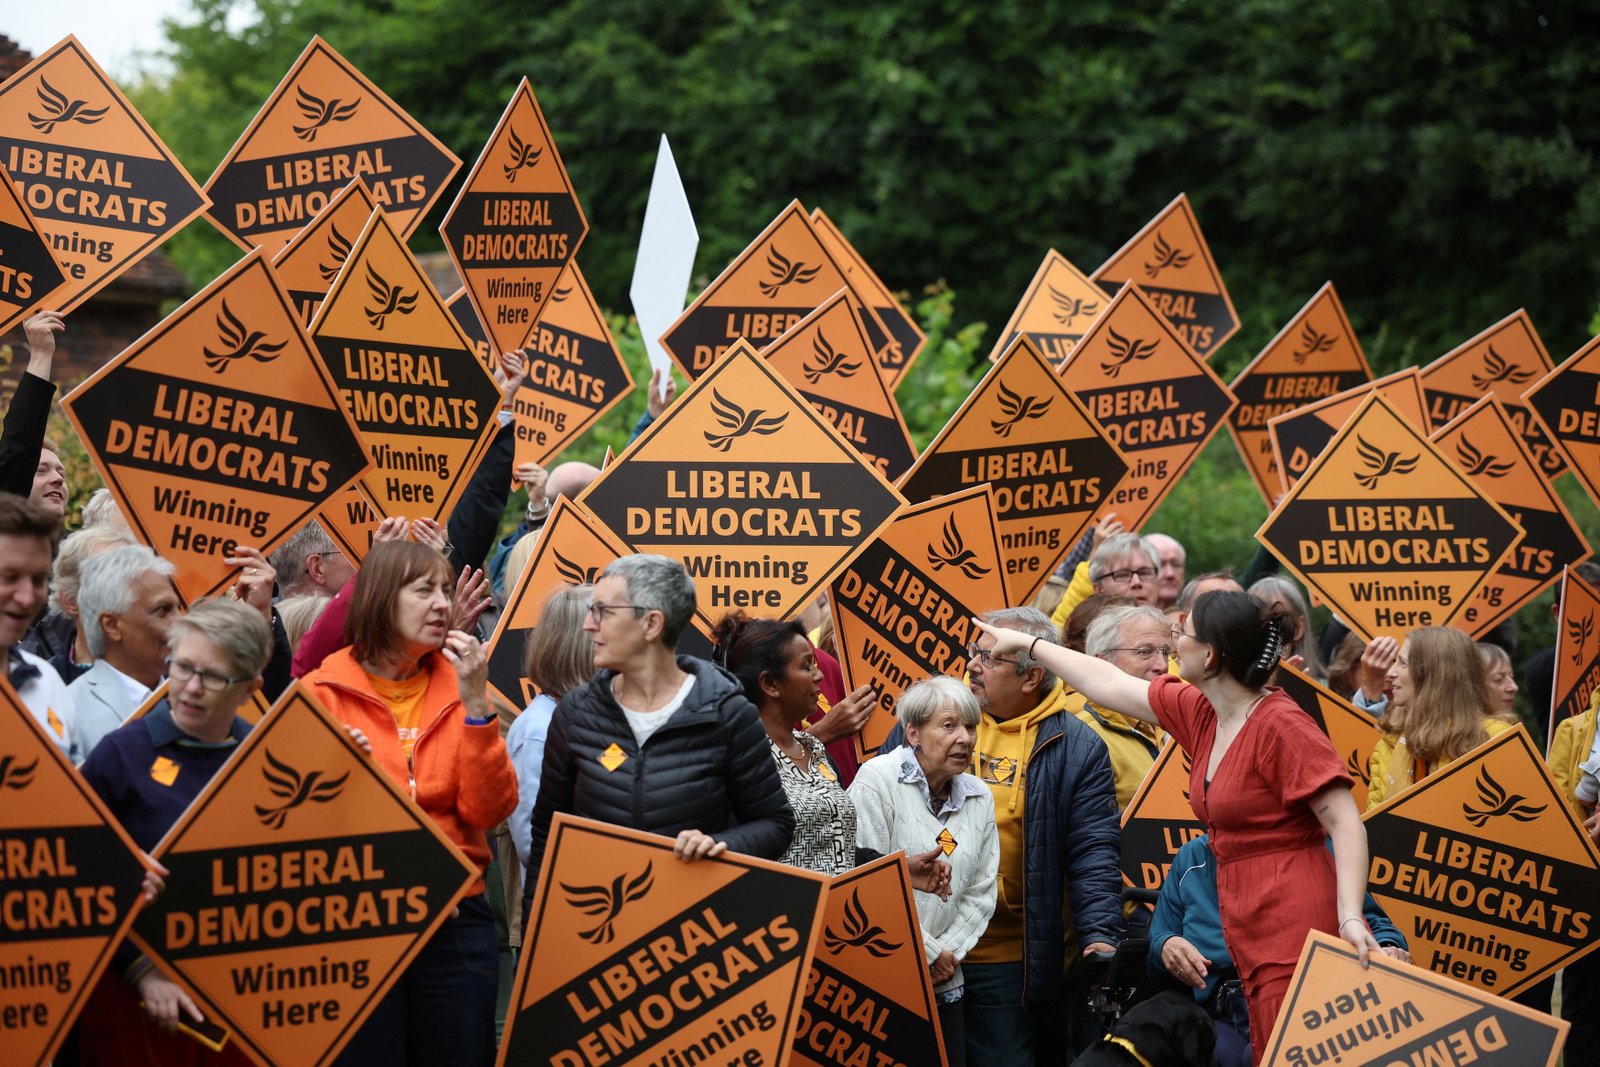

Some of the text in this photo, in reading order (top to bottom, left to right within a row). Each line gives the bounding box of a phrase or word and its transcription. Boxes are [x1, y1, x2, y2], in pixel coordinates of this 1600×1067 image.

[2, 145, 133, 189] IBERAL
[265, 147, 392, 191] LIBERAL
[13, 180, 168, 227] OCRATS
[235, 174, 427, 230] DEMOATS
[483, 199, 553, 226] LIBERAL
[462, 233, 569, 261] DEMOCRATS
[486, 277, 543, 304] Winning
[496, 304, 530, 325] Here
[343, 347, 450, 388] LIBERAL
[1087, 384, 1180, 419] IBERAL
[1263, 376, 1341, 400] LIBERAL
[153, 384, 299, 446] LIBERAL
[339, 388, 479, 431] EMOCRATS
[514, 398, 567, 433] nning
[1102, 410, 1207, 446] OCRATS
[516, 424, 547, 447] ere
[105, 418, 331, 495] DEMOCRATS
[960, 447, 1074, 484] LIBERAL
[386, 476, 435, 504] Here
[666, 470, 821, 499] LIBERAL
[996, 476, 1102, 514] OCRATS
[1109, 486, 1149, 506] ere
[153, 486, 270, 539] Winning
[626, 507, 862, 537] DEMOCRATS
[1327, 505, 1454, 533] LIBERAL
[170, 523, 238, 559] Here
[1000, 525, 1061, 550] nning
[1298, 537, 1491, 566] DEMOCRATS
[683, 554, 809, 585] Winning
[1006, 556, 1040, 575] ere
[711, 584, 782, 607] Here
[1350, 580, 1452, 606] Winning
[838, 567, 967, 681] DEMOCRA
[1374, 608, 1433, 628] Here
[862, 637, 922, 692] Winn
[211, 843, 385, 897] LIBERAL
[1414, 830, 1559, 895] LIBERAL
[3, 885, 118, 932] CRATS
[1368, 855, 1592, 940] DEMOCRATS
[165, 885, 429, 949] DEMOCRATS
[1413, 915, 1531, 973] Winning
[230, 956, 371, 996] Winning
[566, 906, 739, 1024] LIBERAL
[1430, 950, 1498, 987] Here
[549, 914, 800, 1067] DEMOCRATS
[1302, 981, 1382, 1031] Here
[0, 1002, 49, 1030] ere
[262, 999, 341, 1029] Here
[1285, 1000, 1425, 1067] Winning
